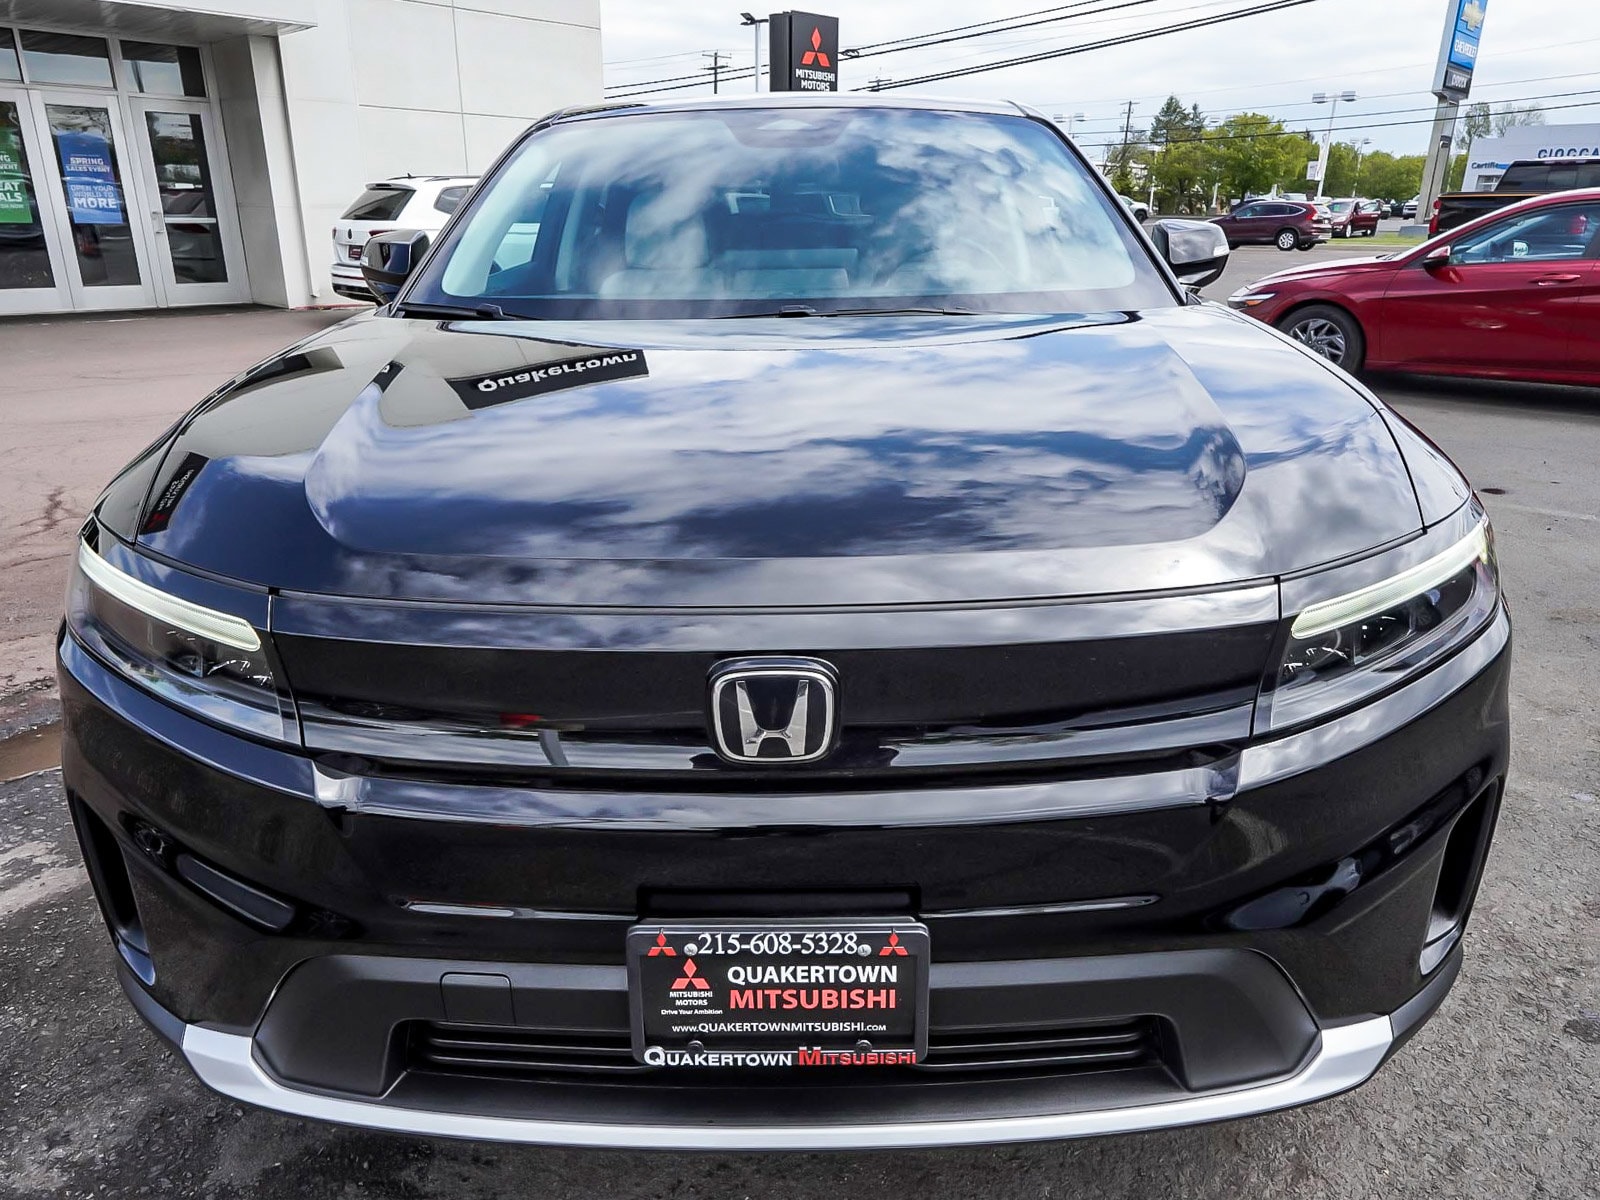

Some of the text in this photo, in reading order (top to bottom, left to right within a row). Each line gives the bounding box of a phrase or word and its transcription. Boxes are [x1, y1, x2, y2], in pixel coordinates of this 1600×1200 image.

[795, 69, 836, 82] MITSUBISHI
[801, 80, 831, 91] MOTORS
[1538, 147, 1600, 159] CIOCCA
[70, 157, 104, 165] SPRING
[93, 184, 114, 192] YOUR
[74, 197, 117, 209] MORE
[698, 931, 858, 955] 215-608-5328
[727, 965, 898, 986] QUAKERTOWN
[729, 989, 897, 1010] MITSUBISHI
[643, 1046, 917, 1067] QUAKERTOWN MITSUBISHI
